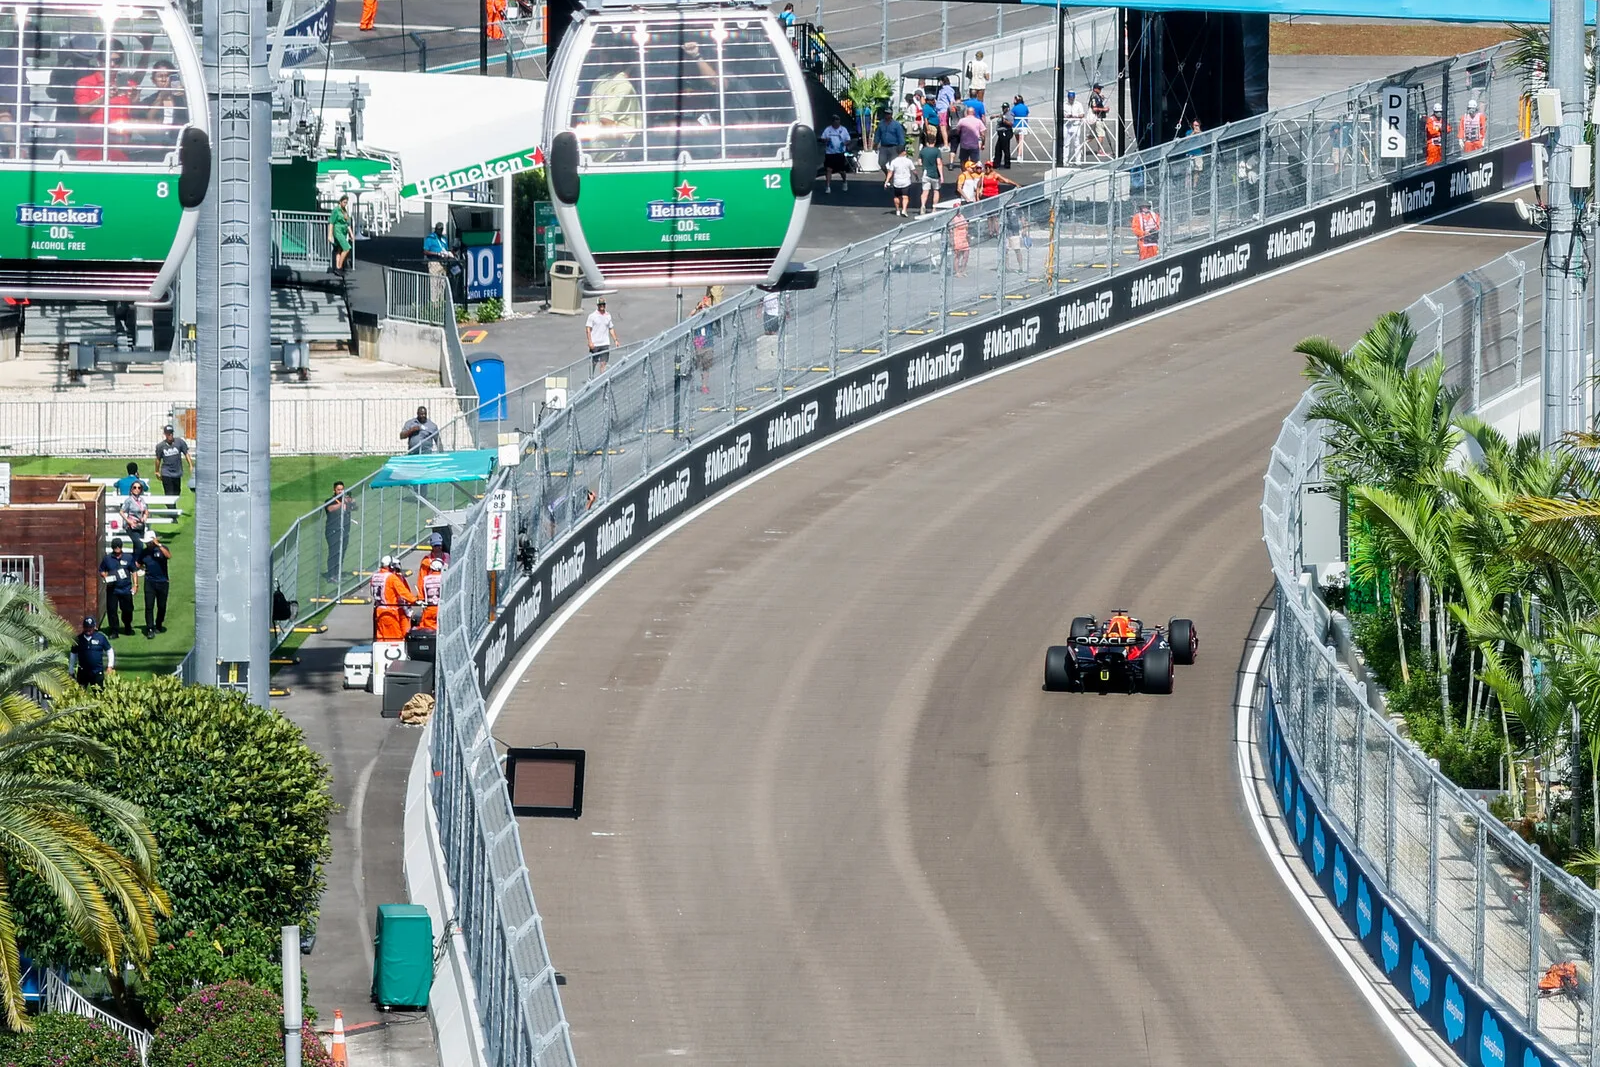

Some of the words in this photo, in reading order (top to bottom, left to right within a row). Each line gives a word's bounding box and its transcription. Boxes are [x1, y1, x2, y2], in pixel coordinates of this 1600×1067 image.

[156, 182, 169, 198] 8
[416, 157, 523, 196] Heineken
[762, 174, 781, 189] 12
[1450, 162, 1493, 197] #MiamiGP
[20, 208, 99, 224] Heineken
[650, 203, 721, 217] Heineken
[1391, 181, 1435, 218] #MiamiGP
[661, 234, 692, 242] ALCOHOL
[694, 233, 710, 241] FREE
[1330, 200, 1375, 238] #MiamiGP
[31, 241, 65, 250] ALCOHOL
[68, 242, 86, 251] FREE
[1267, 221, 1315, 260] #MiamiGP
[1200, 243, 1250, 284] #MiamiGP
[483, 288, 498, 298] FREE
[1131, 266, 1183, 308] #MiamiGP
[1058, 290, 1113, 333] #MiamiGP
[983, 316, 1040, 360] #MiamiGP
[907, 343, 964, 389] #MiamiGP
[835, 371, 889, 419] #MiamiGP
[767, 401, 818, 451] #MiamiGP
[705, 433, 751, 485] #MiamiGP
[648, 467, 690, 521] #MiamiGP
[597, 503, 635, 560] #MiamiGP
[551, 541, 585, 601] #MiamiGP
[1076, 636, 1137, 645] ORACLE
[1446, 998, 1464, 1024] salesforce
[1483, 1035, 1503, 1062] salesforce
